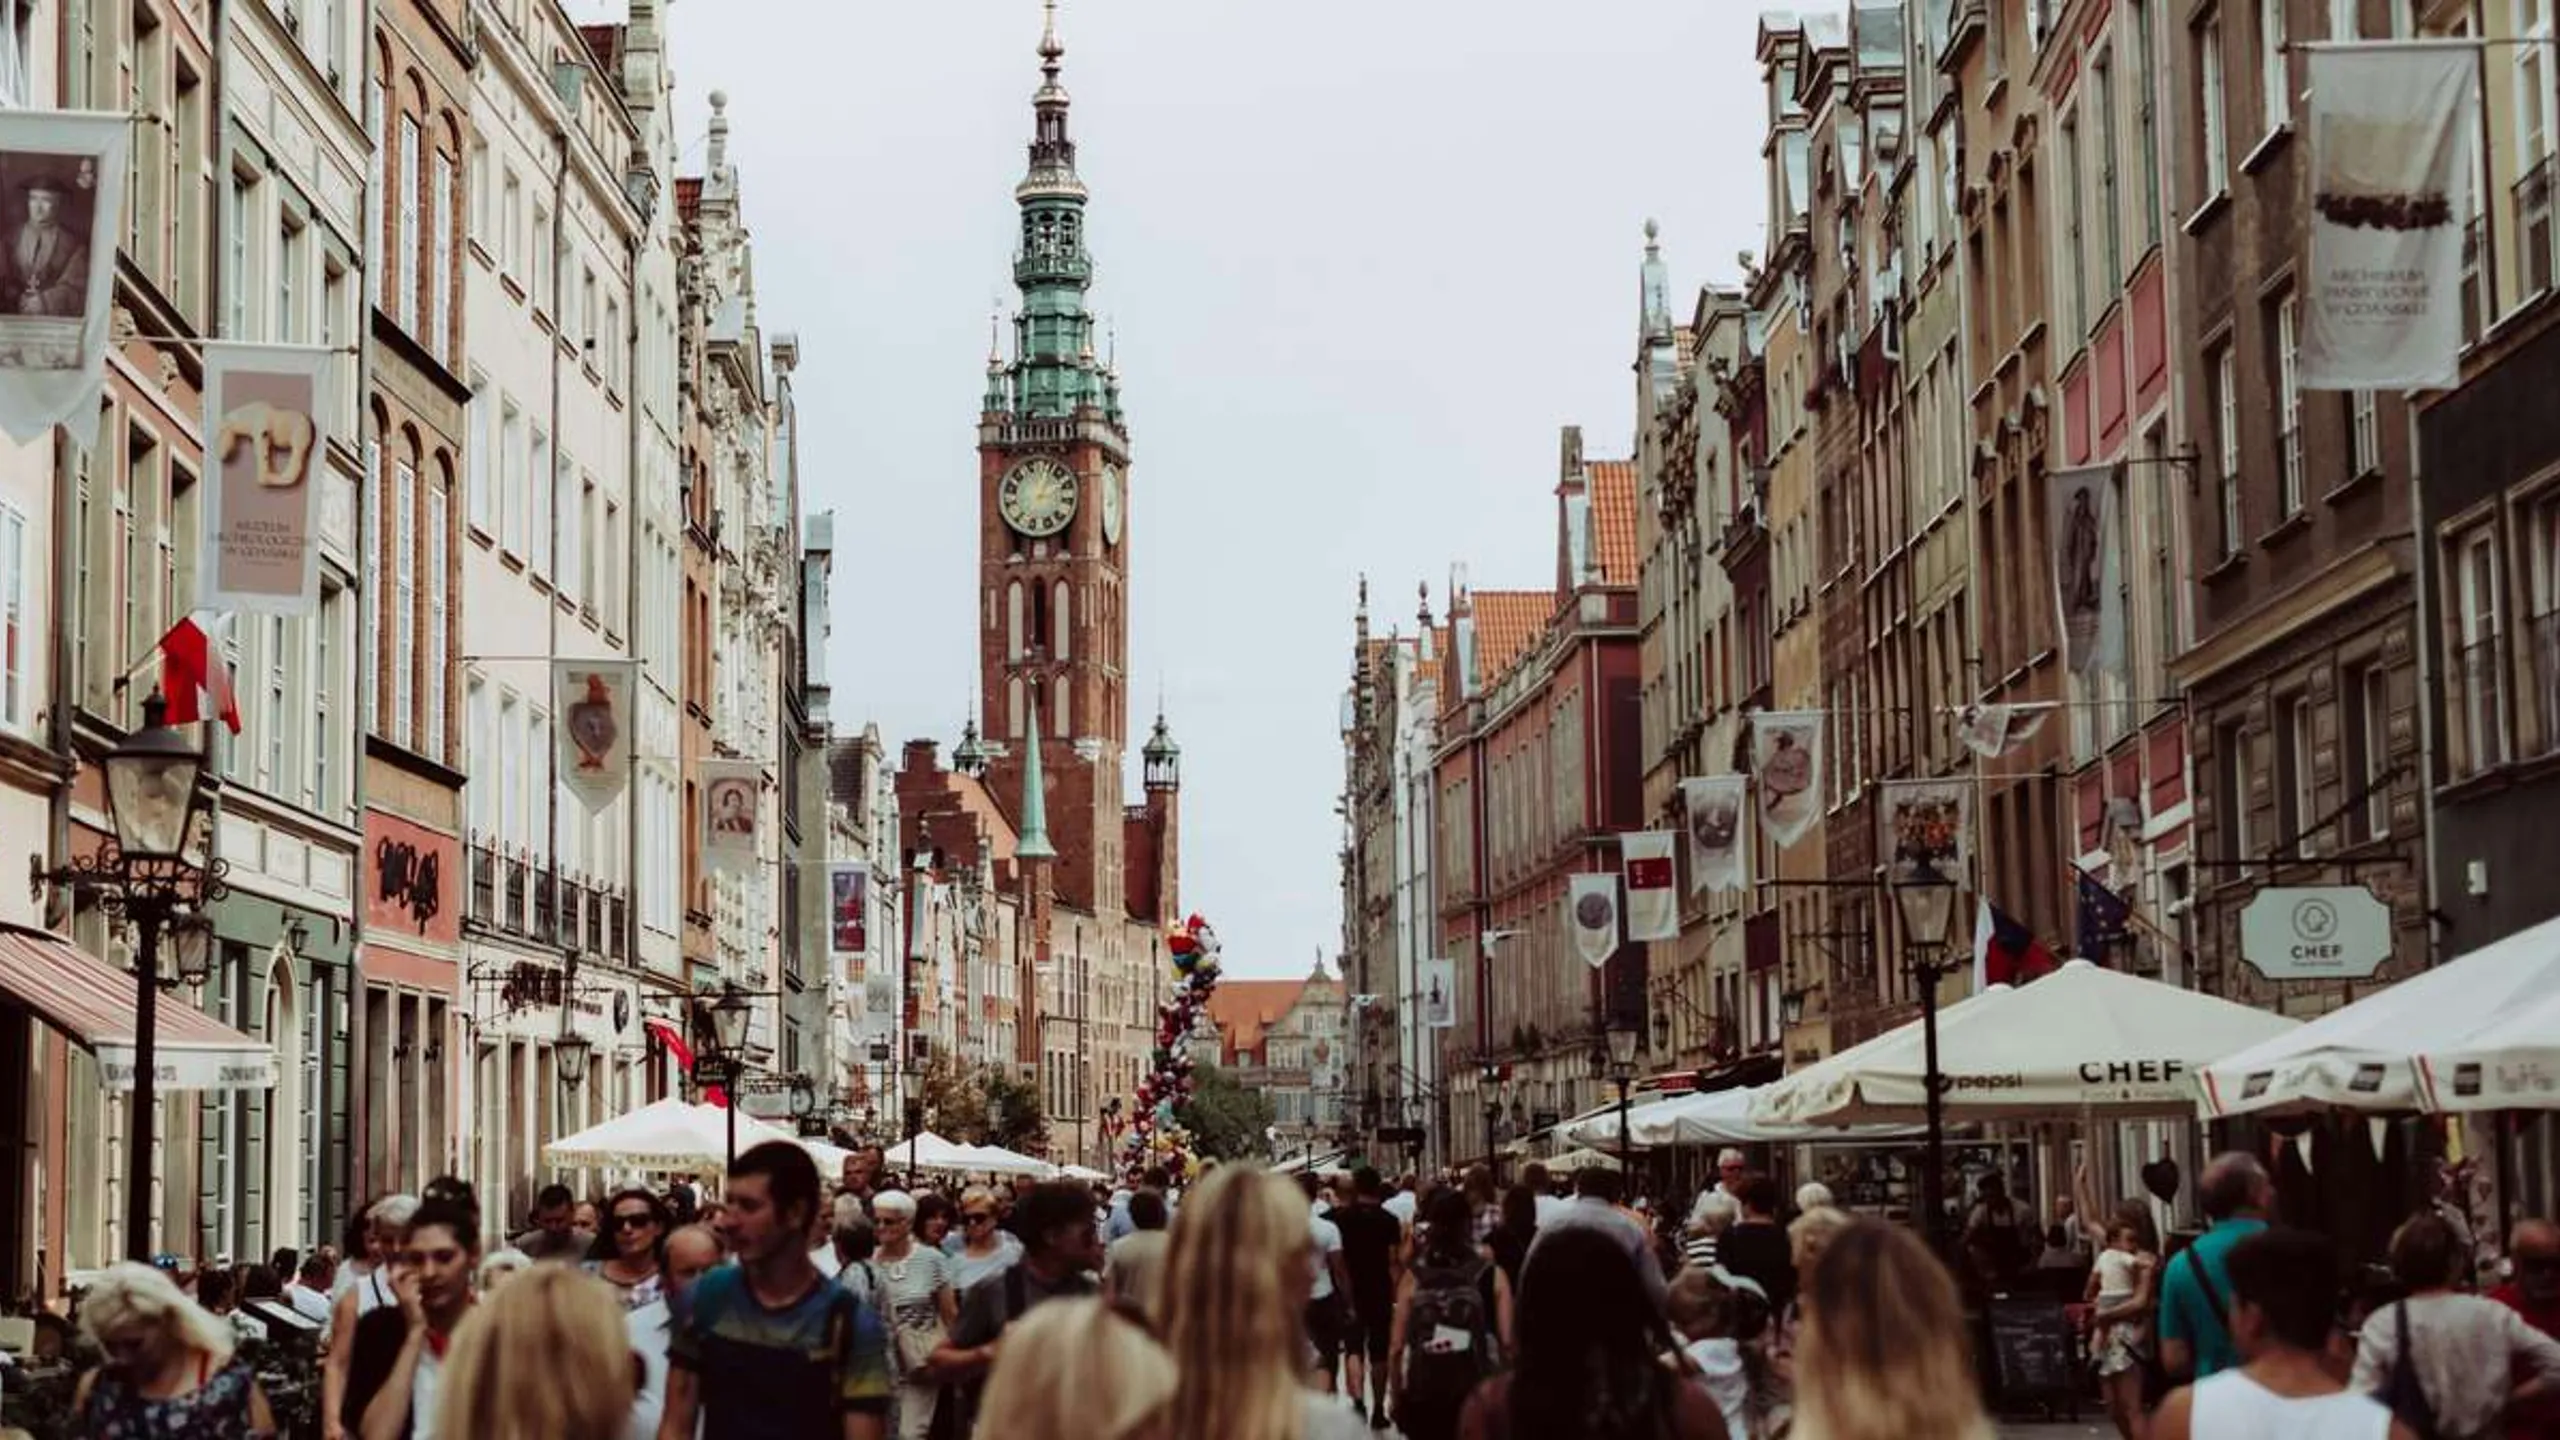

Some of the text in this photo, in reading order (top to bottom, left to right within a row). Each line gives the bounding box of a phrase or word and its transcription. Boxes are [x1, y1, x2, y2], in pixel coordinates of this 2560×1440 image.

[2290, 944, 2343, 960] CHEF
[1956, 1072, 2023, 1091] pepsi
[2079, 1060, 2184, 1085] CHEF
